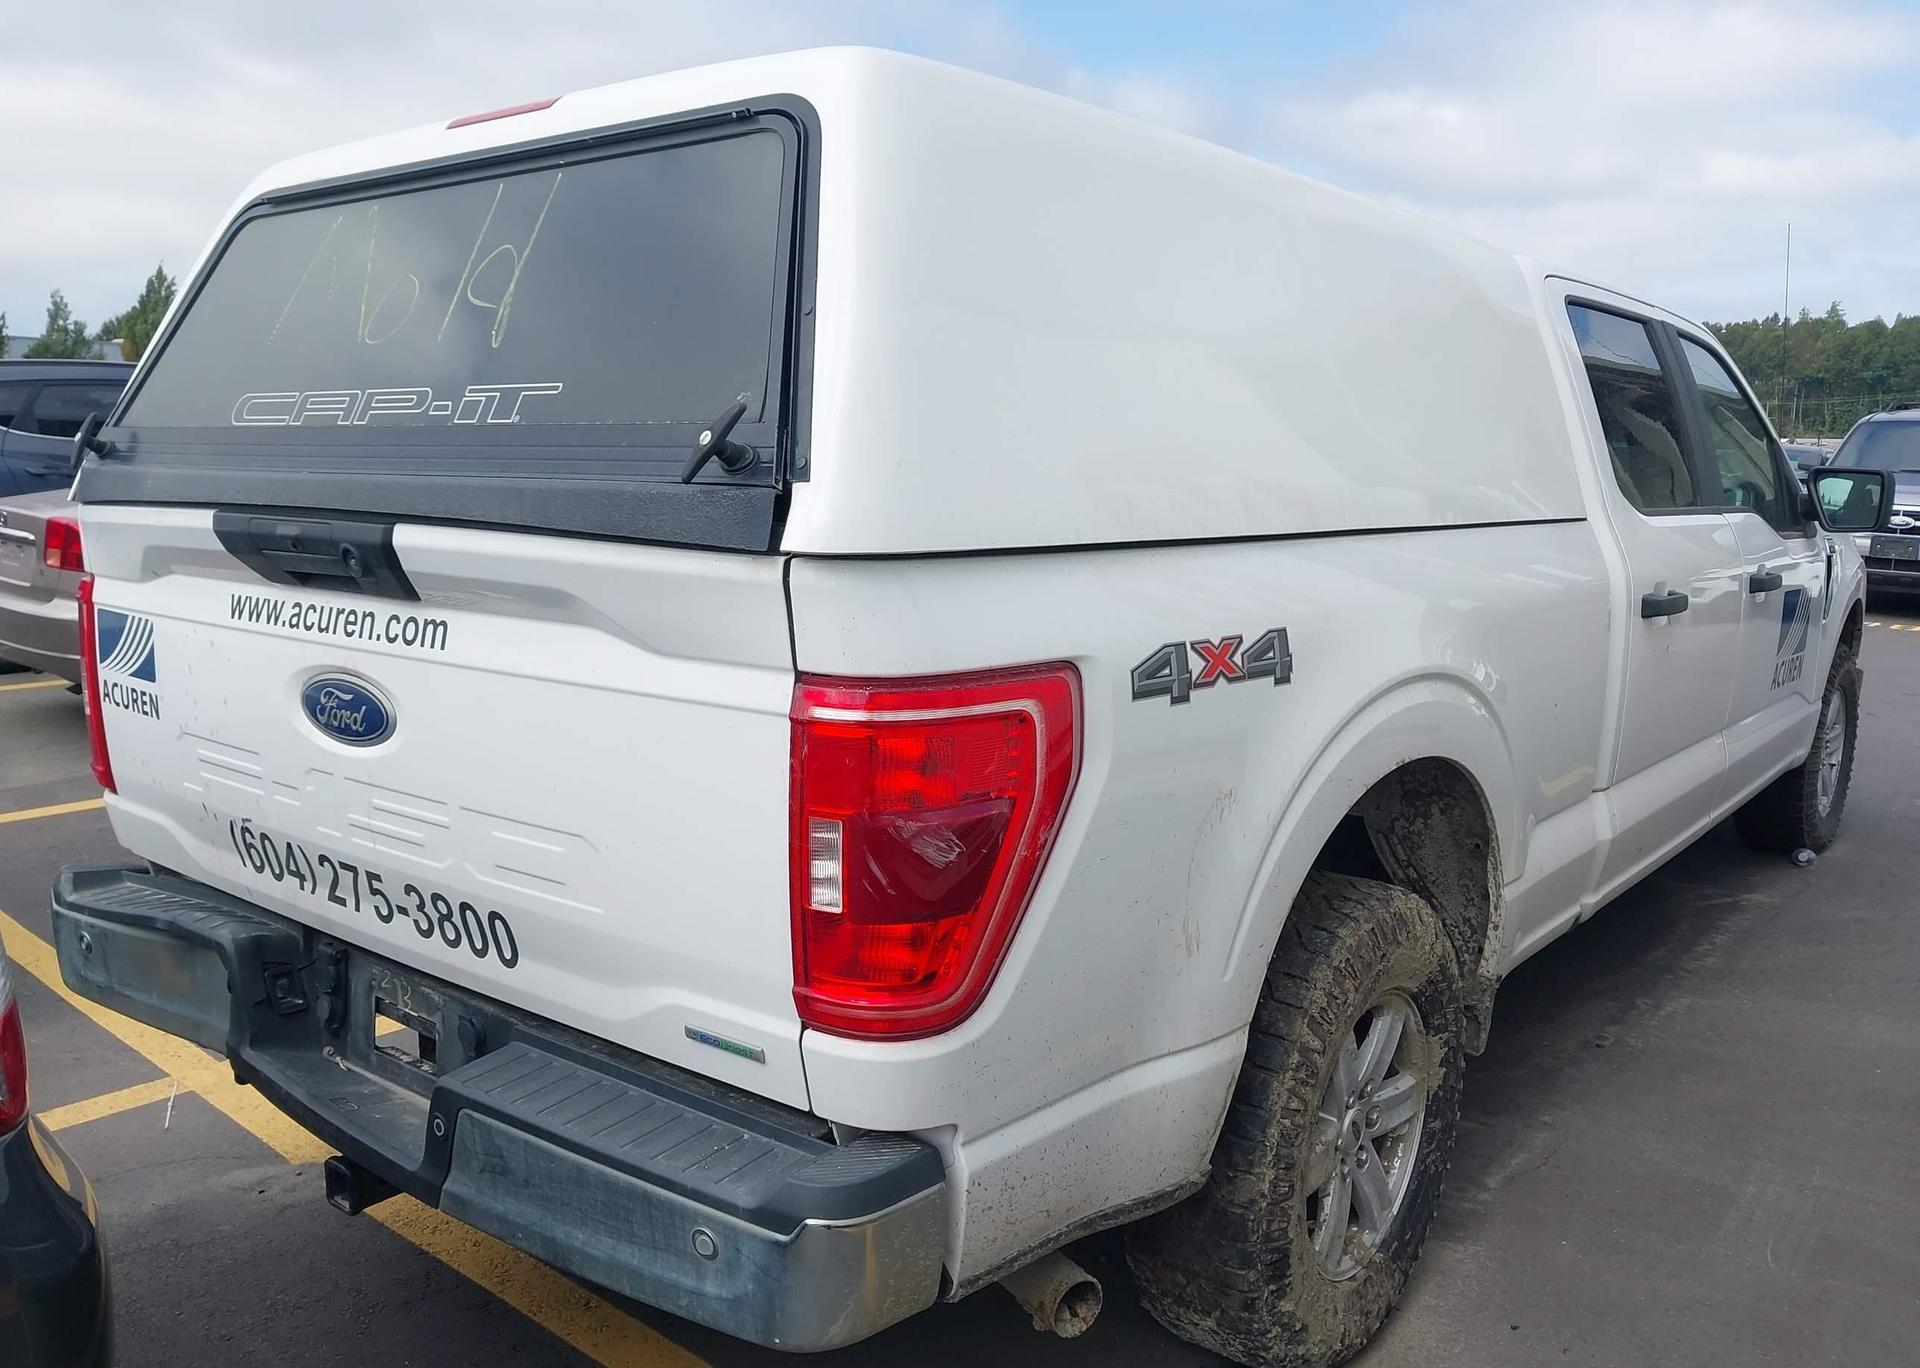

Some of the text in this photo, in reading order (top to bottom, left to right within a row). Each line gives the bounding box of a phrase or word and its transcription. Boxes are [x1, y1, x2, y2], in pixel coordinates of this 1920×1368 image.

[230, 593, 449, 651] www.acuren.com
[1770, 652, 1806, 692] ACUREN
[102, 679, 161, 720] ACUREN
[315, 687, 367, 732] Ford
